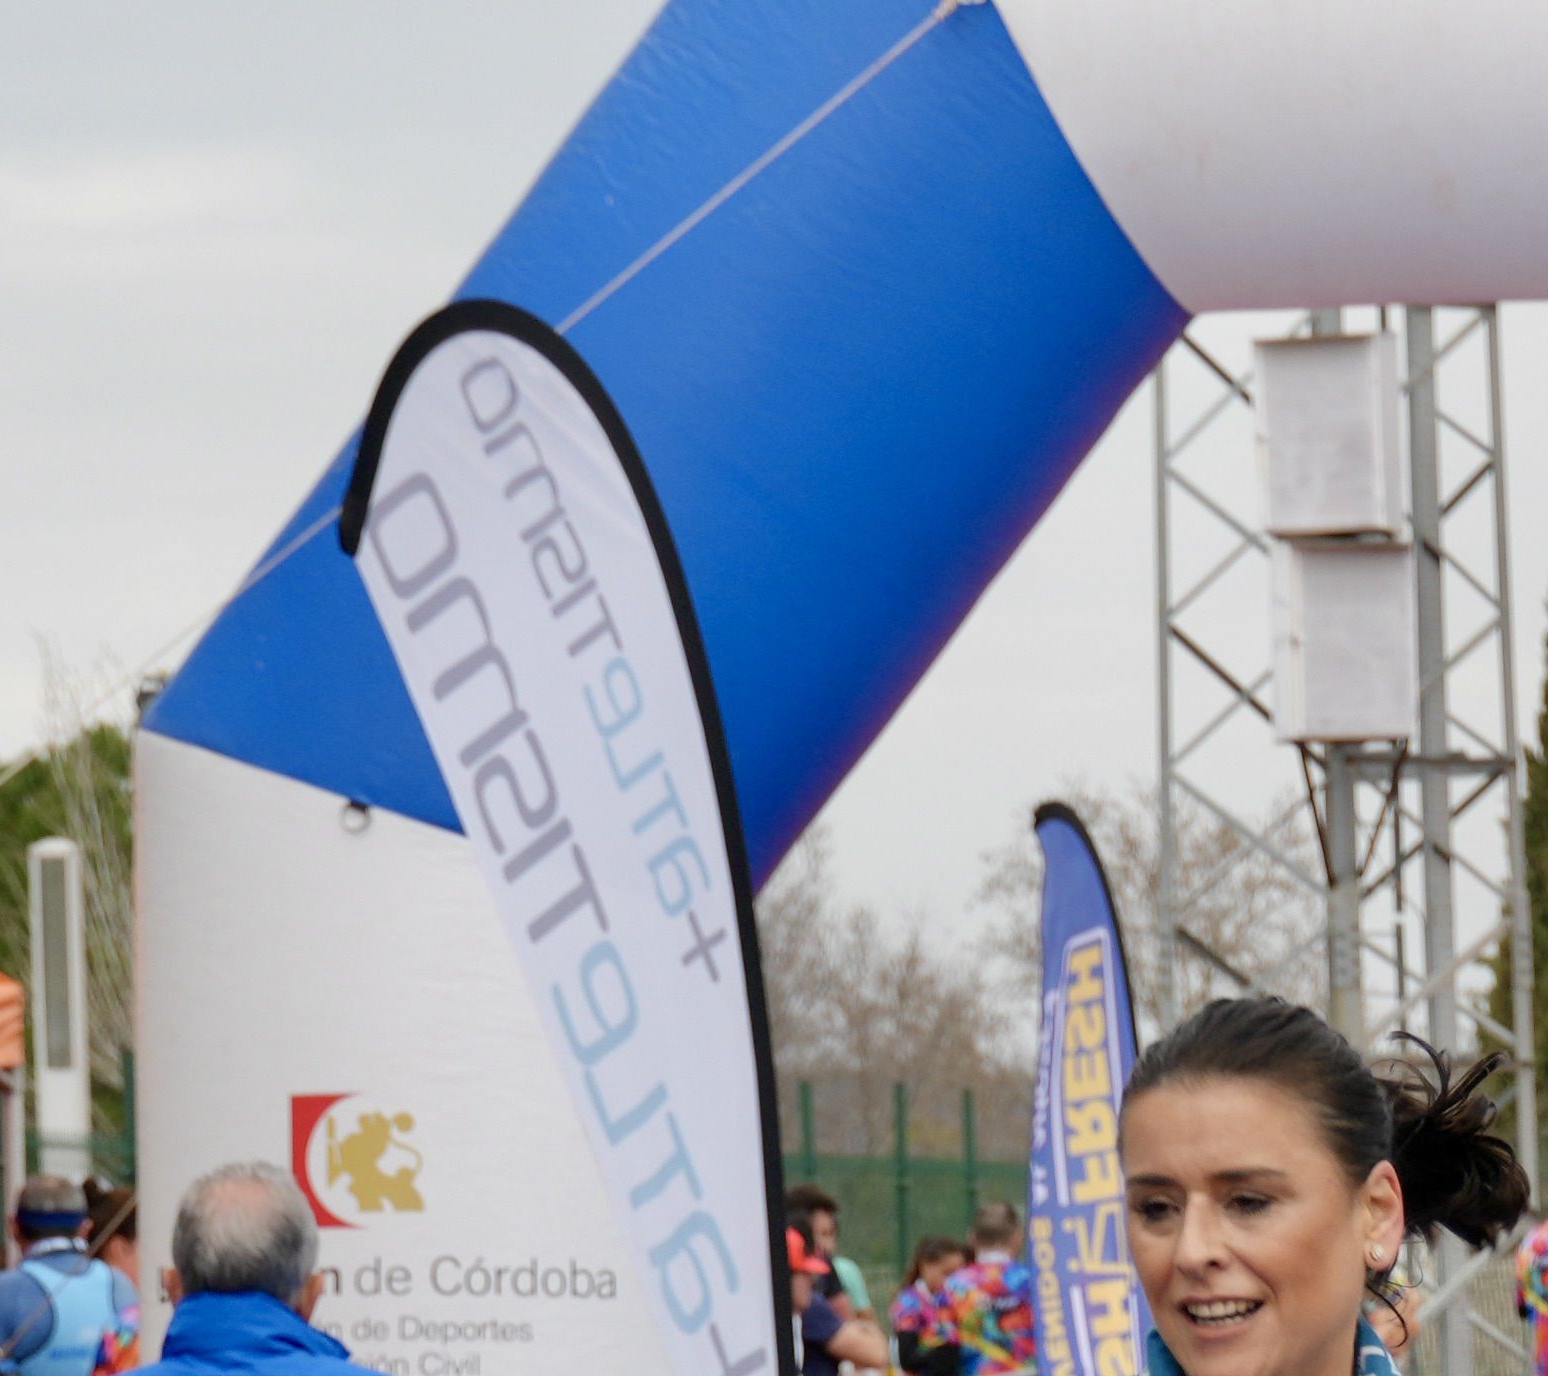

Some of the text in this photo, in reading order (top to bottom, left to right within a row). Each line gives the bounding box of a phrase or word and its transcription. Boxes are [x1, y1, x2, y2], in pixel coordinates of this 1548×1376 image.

[354, 1257, 412, 1297] de
[429, 1255, 618, 1300] Córdoba
[355, 1319, 390, 1341] de
[398, 1316, 534, 1344] Deportes
